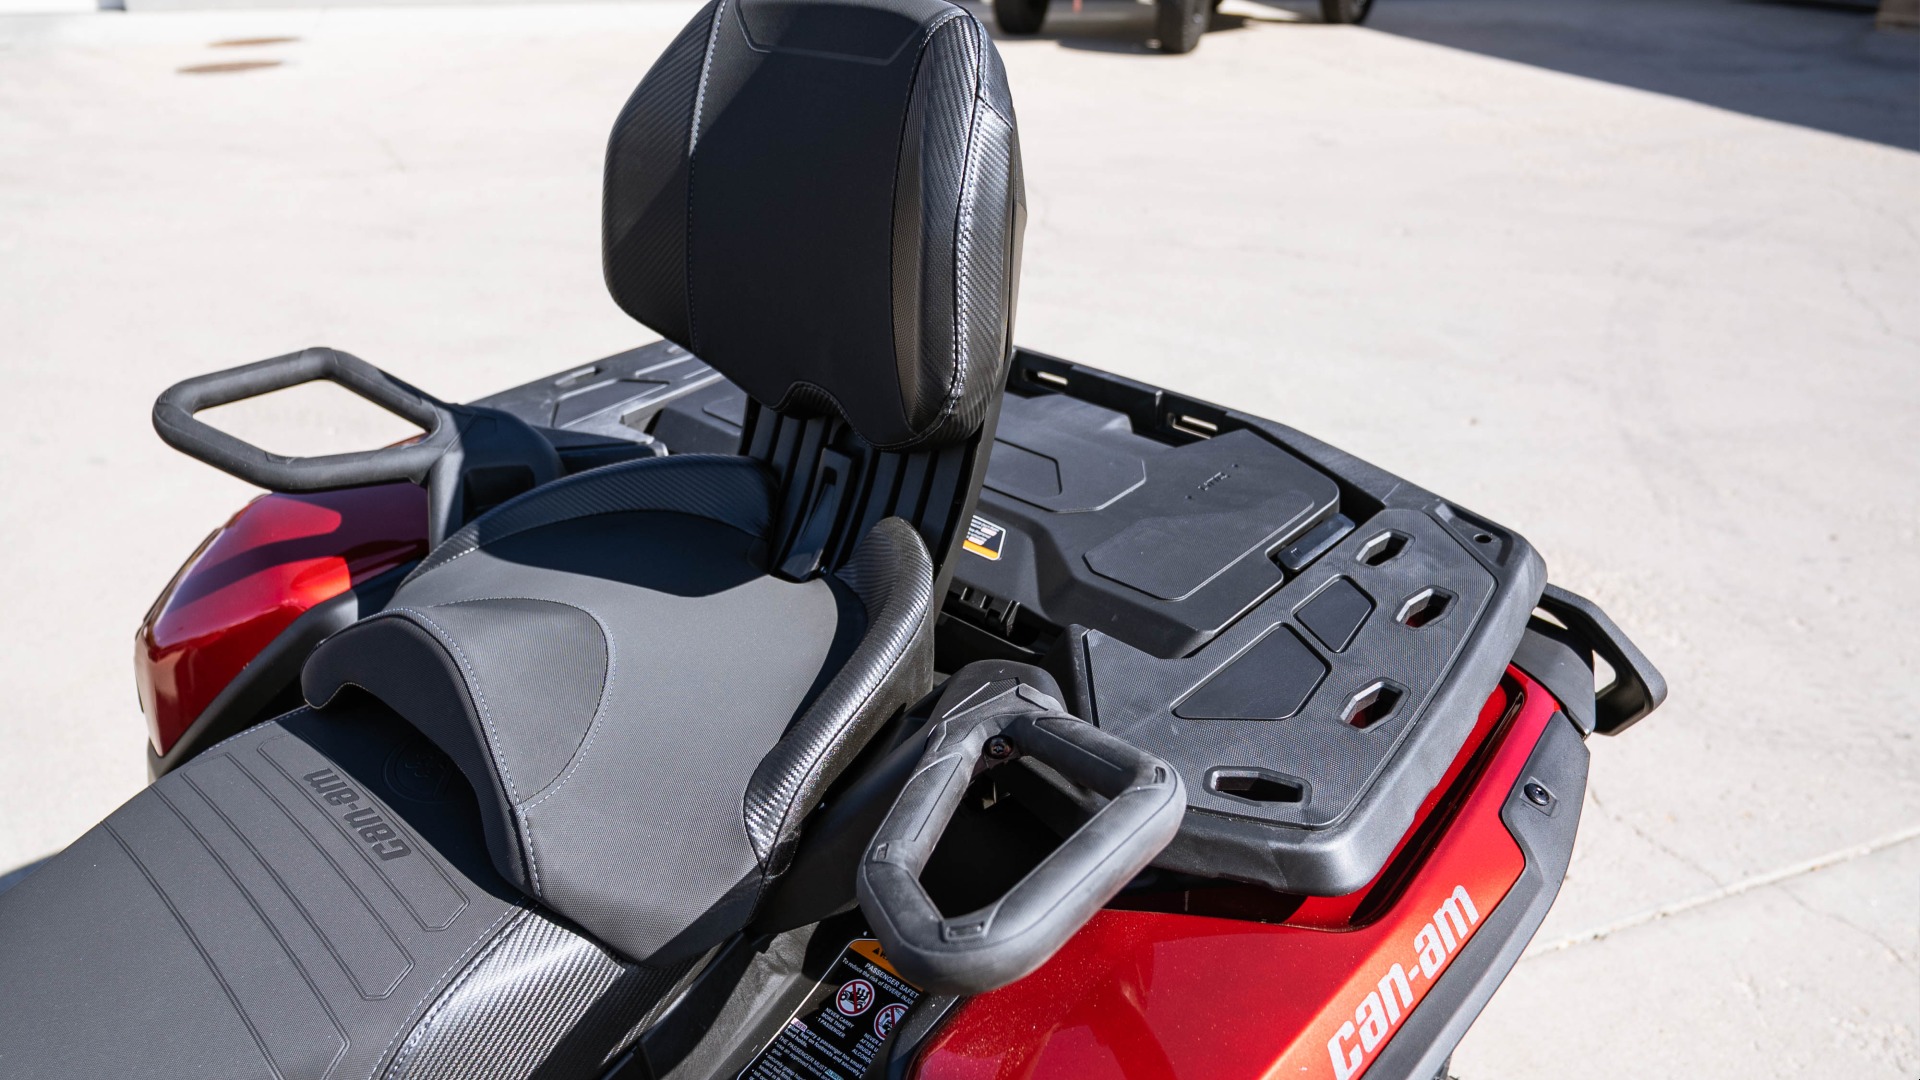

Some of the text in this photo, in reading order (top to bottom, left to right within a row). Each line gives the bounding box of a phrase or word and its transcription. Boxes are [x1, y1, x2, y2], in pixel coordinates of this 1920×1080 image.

[303, 768, 411, 861] can-am
[848, 962, 863, 973] reduce
[862, 970, 871, 978] the
[870, 975, 879, 983] risk
[883, 983, 902, 997] SEVERE
[901, 995, 914, 1005] INJU
[865, 963, 919, 999] PASSENGER SAFET
[1327, 885, 1479, 1080] can-am
[821, 1013, 846, 1030] MORE THAN
[825, 1008, 854, 1028] NEVER CARRY
[820, 1019, 846, 1038] PASSENGER
[819, 1039, 843, 1056] passenger
[860, 1038, 875, 1050] AFTER
[864, 1033, 879, 1045] NEVER
[779, 1036, 789, 1044] THE
[787, 1042, 815, 1062] PASSENGER
[813, 1059, 828, 1071] MUST
[856, 1043, 871, 1055] DRUGS
